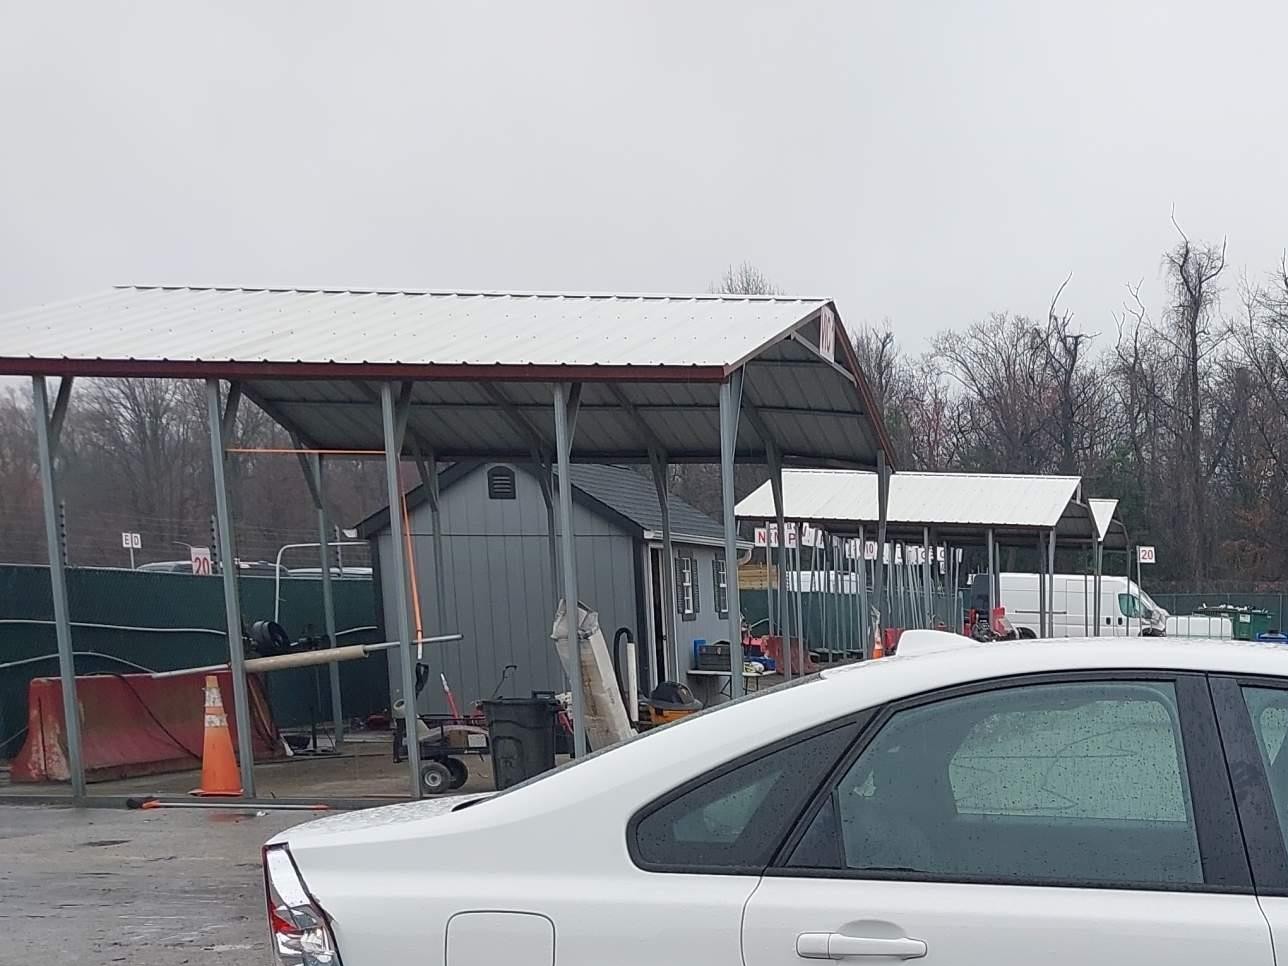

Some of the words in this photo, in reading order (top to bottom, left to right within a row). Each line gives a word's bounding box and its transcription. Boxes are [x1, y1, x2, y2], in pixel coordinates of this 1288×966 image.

[758, 531, 766, 544] N
[1141, 549, 1154, 560] 20
[194, 556, 210, 576] 20
